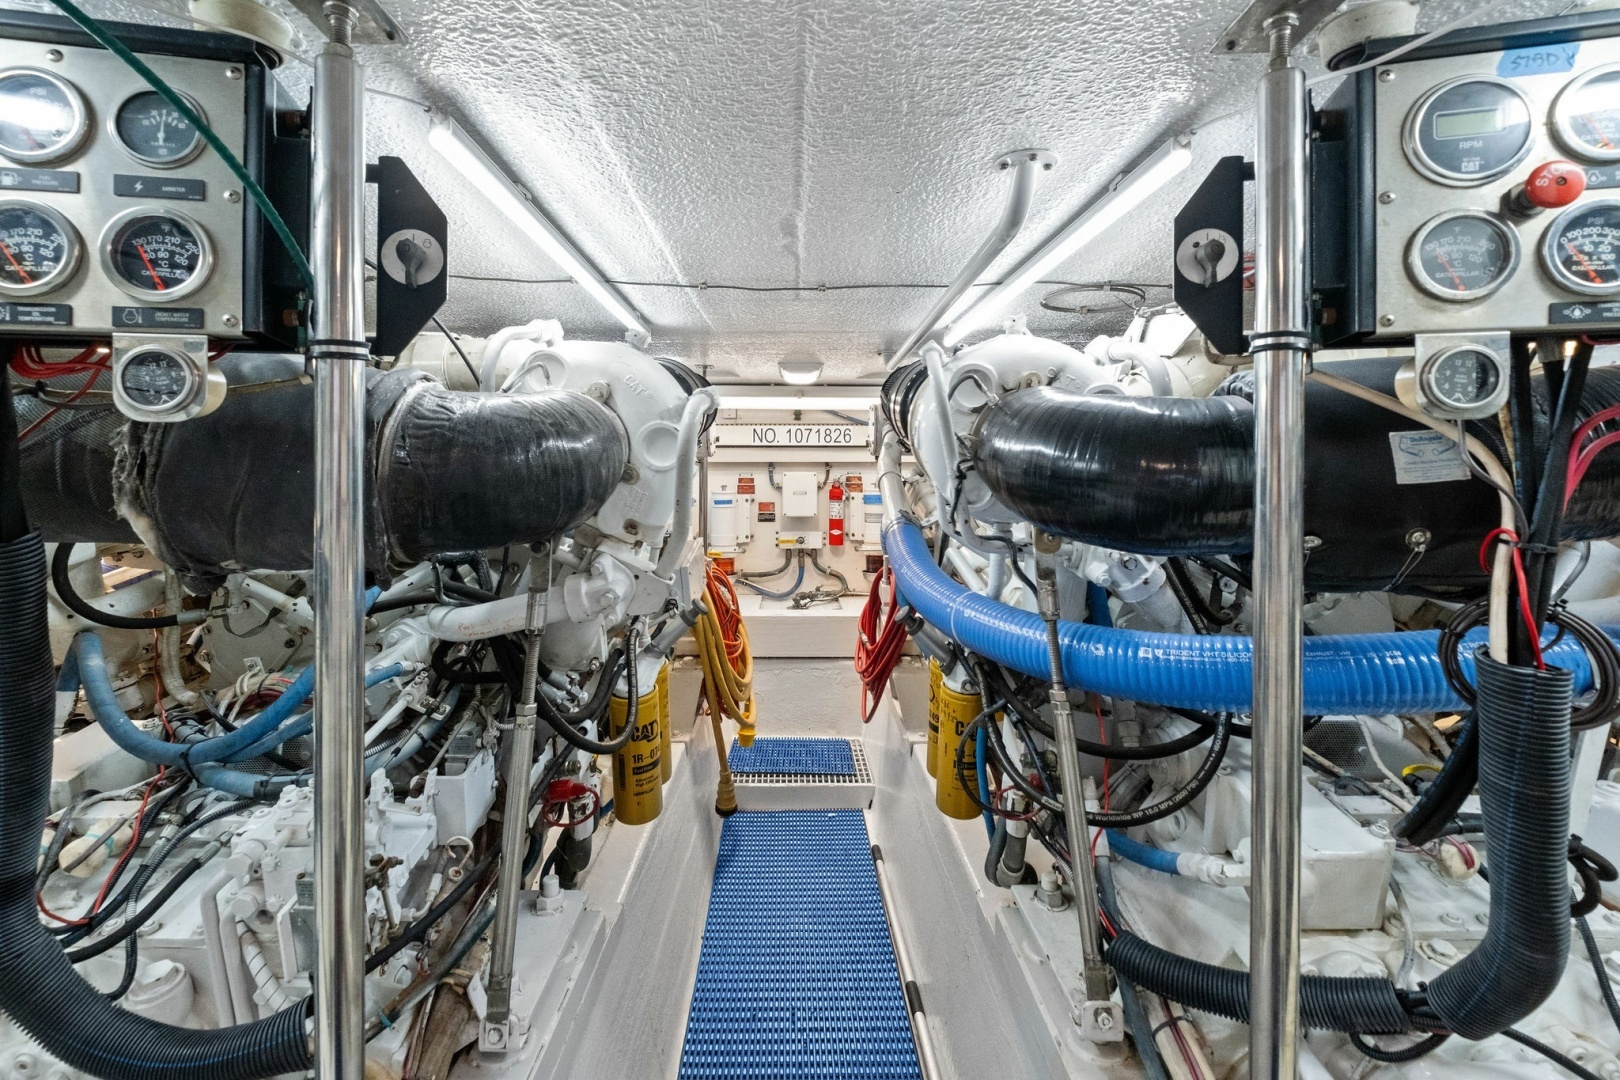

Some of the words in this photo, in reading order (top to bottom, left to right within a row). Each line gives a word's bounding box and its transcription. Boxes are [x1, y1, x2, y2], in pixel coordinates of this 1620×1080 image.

[30, 87, 47, 96] PSI
[1459, 140, 1483, 149] RPM
[1461, 161, 1480, 172] CAT
[1587, 217, 1605, 225] PSI
[10, 228, 25, 236] 170
[27, 228, 43, 236] 210
[1566, 229, 1582, 239] 100
[1583, 227, 1602, 235] 200
[1602, 227, 1620, 236] 300
[132, 237, 147, 247] 130
[147, 235, 163, 243] 170
[164, 236, 181, 244] 210
[1441, 236, 1454, 244] 170
[1457, 235, 1472, 243] 210
[39, 246, 54, 257] 120
[174, 254, 188, 266] 120
[753, 428, 779, 443] NO.
[786, 428, 852, 443] 1071826
[631, 719, 657, 743] CAT
[1095, 813, 1131, 821] Worldwide
[1132, 811, 1144, 819] WP
[1159, 800, 1174, 811] MPa
